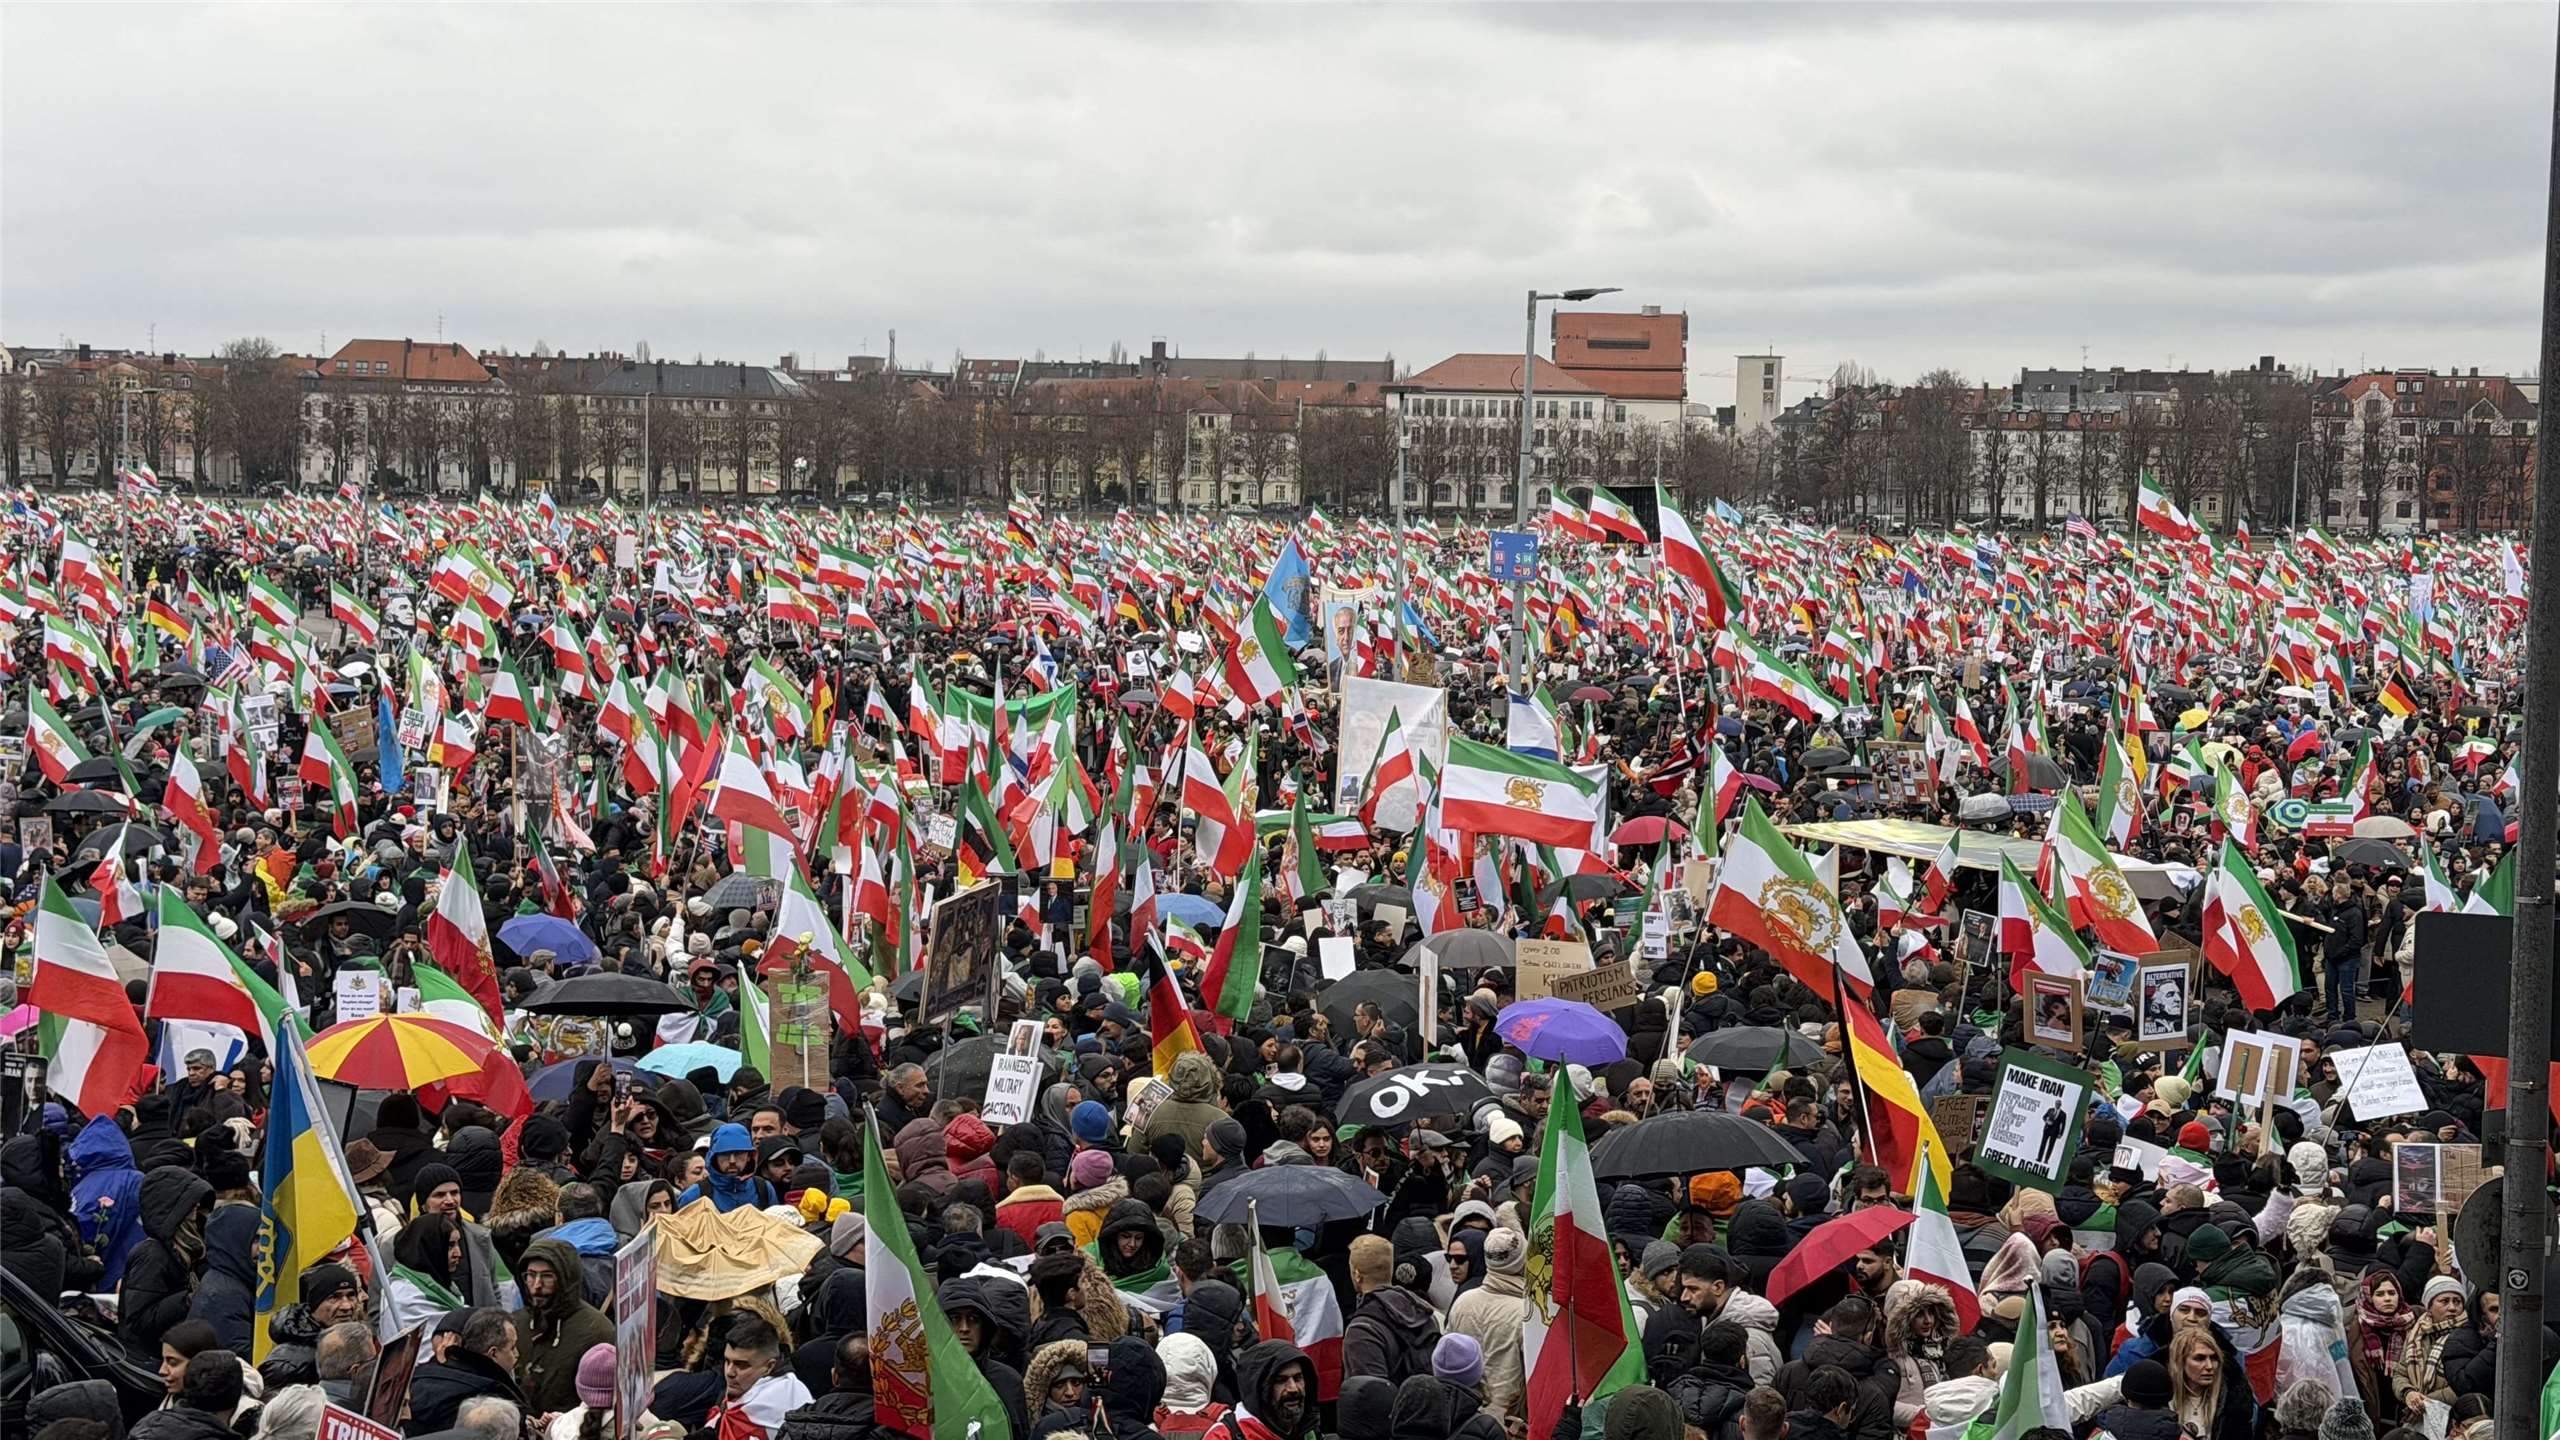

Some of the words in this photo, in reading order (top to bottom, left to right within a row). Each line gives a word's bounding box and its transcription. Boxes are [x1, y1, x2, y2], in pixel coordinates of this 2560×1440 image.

[1559, 968, 1625, 993] PATRIOTISM
[1582, 982, 1634, 1004] PERSIANS
[998, 1058, 1014, 1072] IRAN
[1013, 1060, 1033, 1074] NEEDS
[992, 1077, 1024, 1095] MILITARY
[2007, 1068, 2038, 1090] MAKE
[2039, 1077, 2066, 1098] IRAN
[991, 1102, 1016, 1116] ACTION
[1936, 1096, 1969, 1113] FREE
[1984, 1147, 2020, 1169] GREAT
[2018, 1159, 2050, 1179] AGAIN
